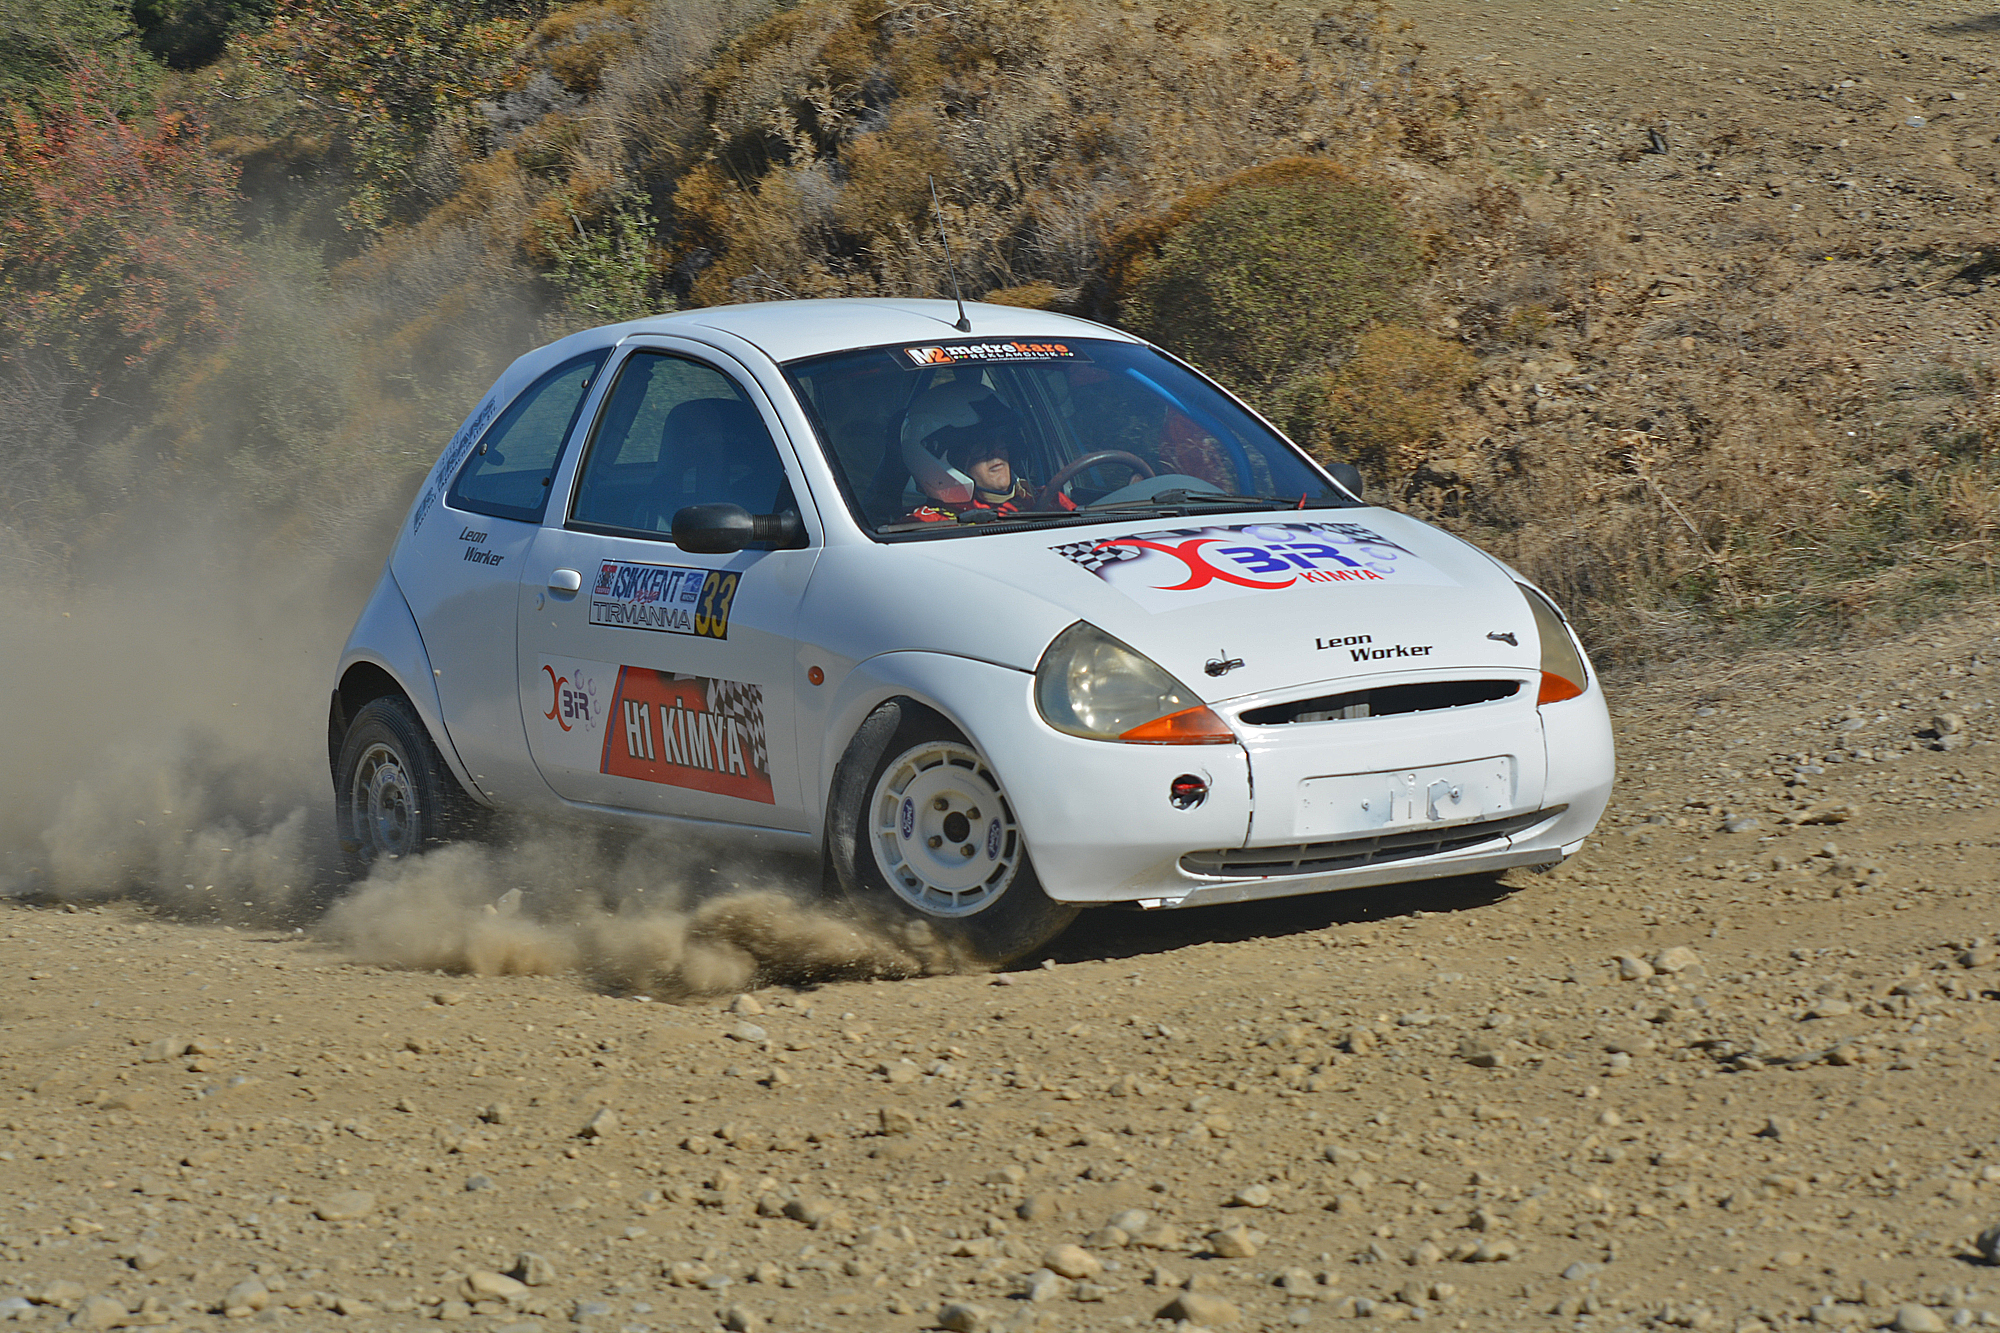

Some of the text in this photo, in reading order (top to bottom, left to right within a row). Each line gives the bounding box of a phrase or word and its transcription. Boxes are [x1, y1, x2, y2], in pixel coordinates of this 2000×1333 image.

[946, 342, 1068, 356] metrekare
[459, 526, 488, 544] Leon
[463, 546, 504, 566] Worker
[695, 572, 737, 638] 33
[593, 601, 691, 630] TIRMANMA
[1316, 634, 1372, 651] Leon
[1350, 644, 1433, 662] Worker
[623, 699, 656, 761] H1
